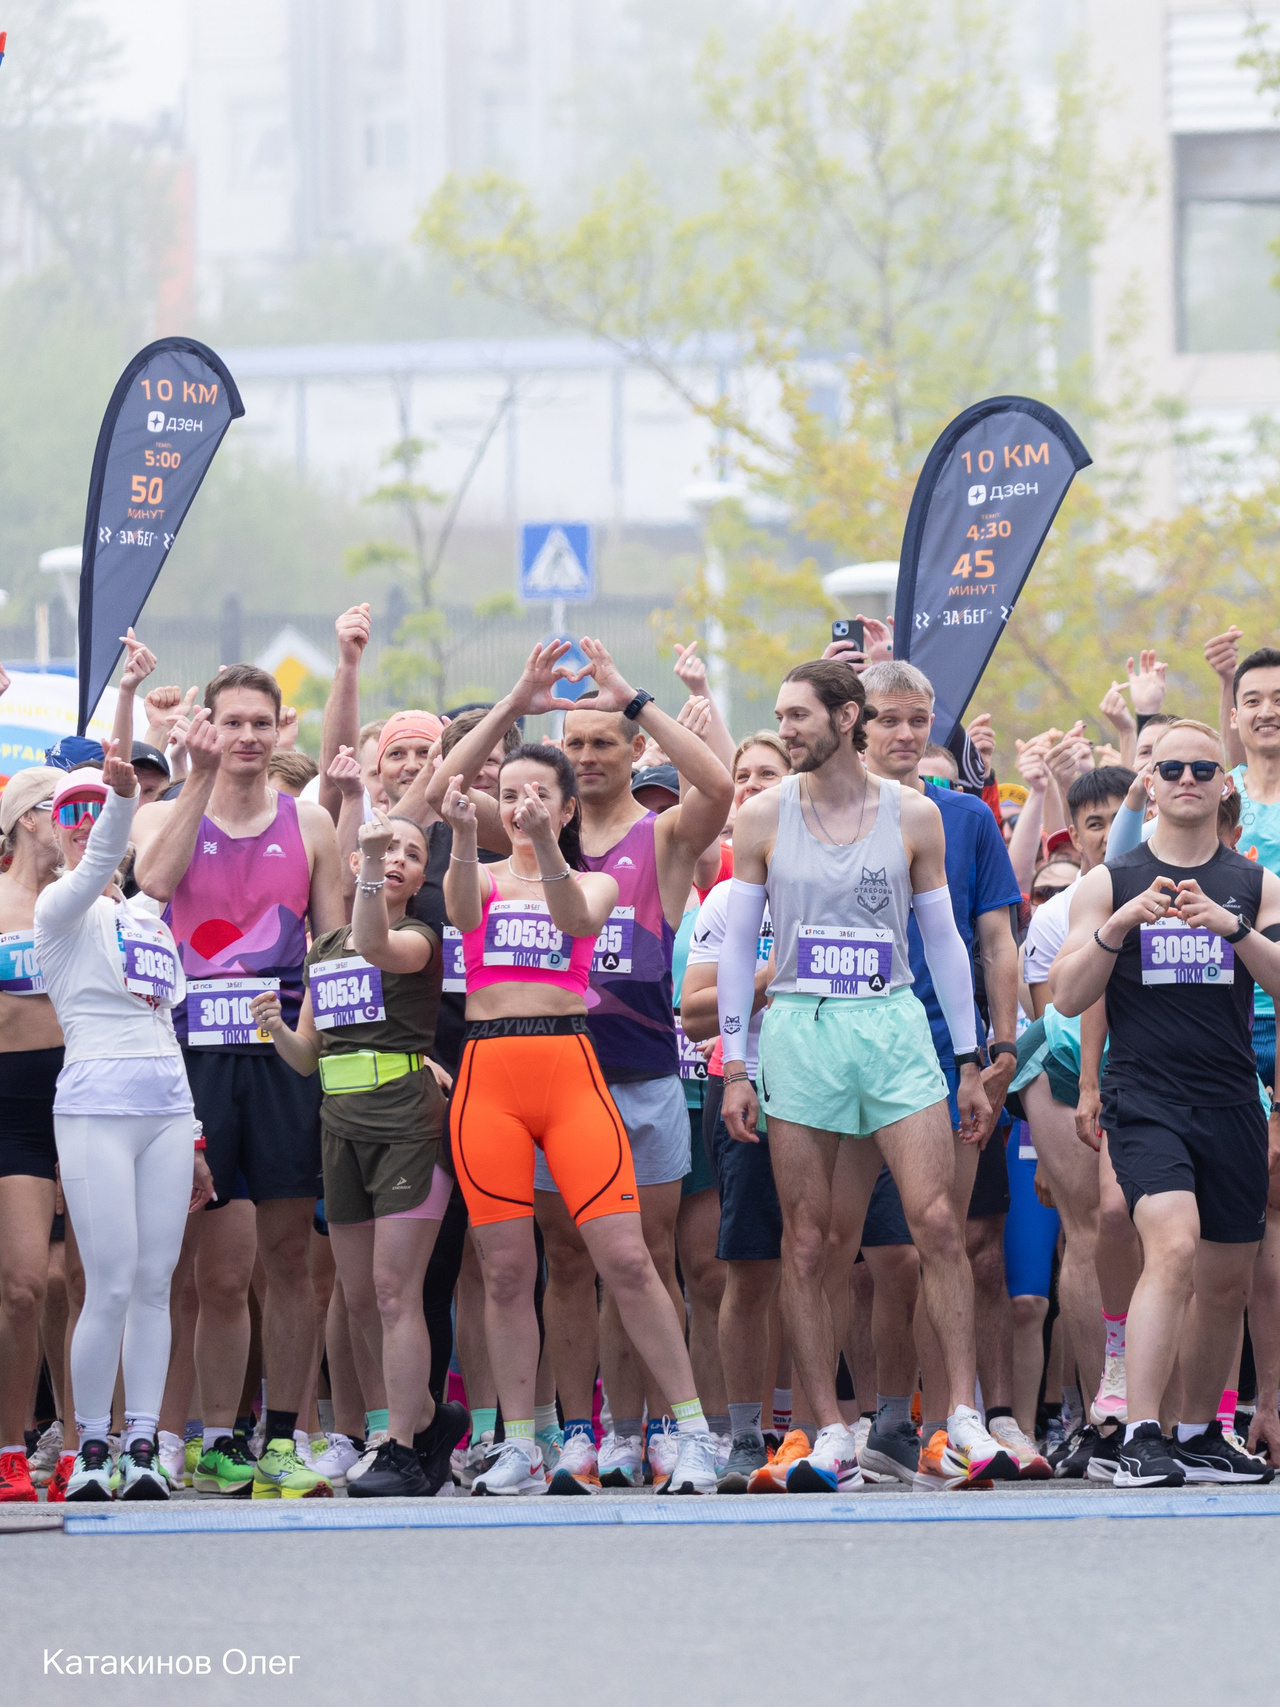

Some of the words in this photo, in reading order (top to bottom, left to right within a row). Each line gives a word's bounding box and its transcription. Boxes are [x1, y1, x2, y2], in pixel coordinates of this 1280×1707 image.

[141, 379, 173, 401] 10
[166, 417, 203, 432] дзен
[145, 451, 181, 469] 5:00
[961, 450, 994, 474] 10
[131, 475, 163, 505] 50
[990, 482, 1038, 501] дзен
[128, 508, 165, 520] МИНУТ
[966, 520, 1012, 541] 4:30
[952, 550, 995, 579] 45
[948, 584, 997, 596] МИНУТ
[494, 919, 563, 951] 30533
[1151, 935, 1224, 964] 30954
[550, 954, 560, 965] D
[605, 956, 616, 968] A
[810, 945, 879, 977] 30816
[1207, 967, 1217, 977] D
[871, 977, 882, 988] A
[317, 975, 373, 1011] 30534
[365, 1006, 375, 1017] C
[467, 1018, 558, 1039] EAZYWAY
[695, 1064, 706, 1075] A
